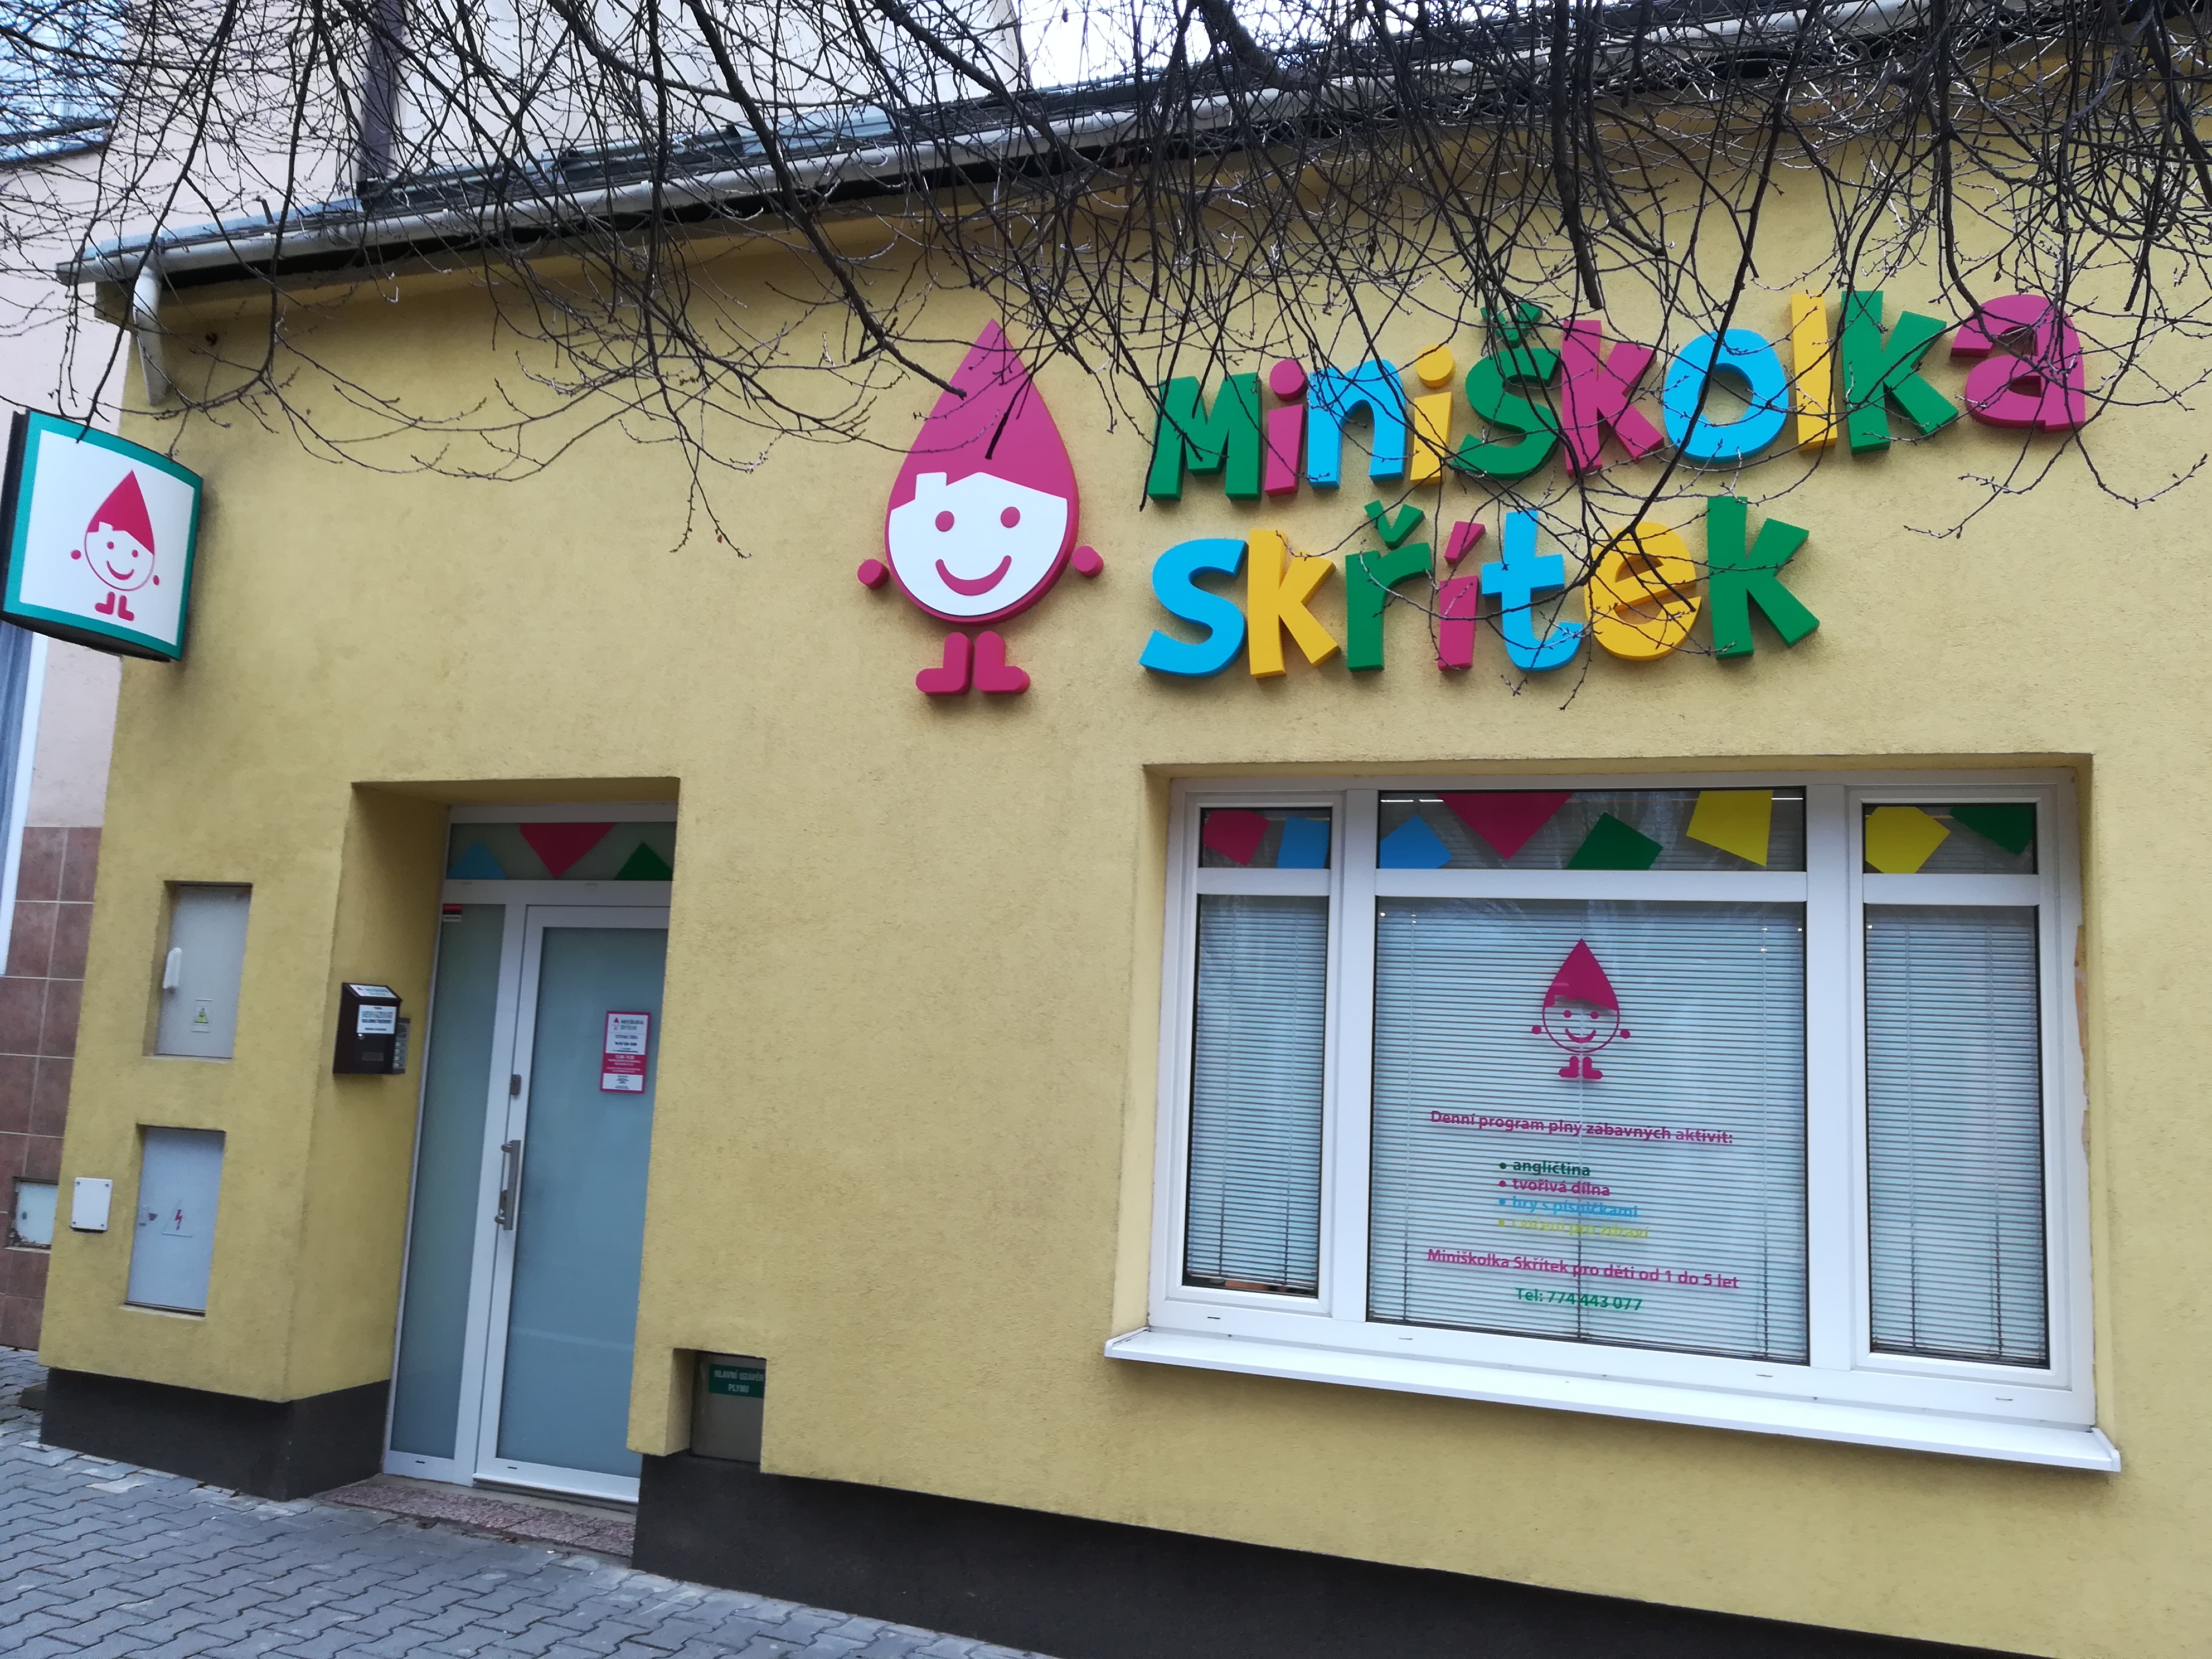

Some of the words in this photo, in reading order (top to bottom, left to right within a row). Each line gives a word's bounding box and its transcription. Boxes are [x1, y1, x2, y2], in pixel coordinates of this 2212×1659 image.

[1146, 290, 2087, 501] Miniškolka
[1139, 495, 1820, 678] Skřítek
[1430, 1110, 1476, 1125] Denní
[1479, 1117, 1544, 1132] program
[1549, 1119, 1582, 1137] plný
[1586, 1122, 1671, 1141] zábavných
[1676, 1128, 1733, 1143] aktivit:
[1512, 1161, 1590, 1176] angličtina
[1512, 1178, 1567, 1193] tvořivá
[1571, 1181, 1611, 1196] dílna
[1512, 1196, 1539, 1212] hry
[1542, 1201, 1549, 1211] s
[1553, 1199, 1638, 1217] písničkami
[1600, 1224, 1648, 1239] zdraví
[1427, 1249, 1510, 1268] Miniškolka
[1513, 1256, 1569, 1273] Skřítek
[1573, 1263, 1599, 1277] pro
[1604, 1264, 1634, 1279] děti
[1639, 1268, 1660, 1282] od
[1665, 1270, 1672, 1283] 1
[1678, 1270, 1699, 1285] do
[1703, 1274, 1713, 1286] 5
[1718, 1274, 1739, 1289] let
[1515, 1287, 1544, 1302] Tel:
[1548, 1291, 1575, 1305] 774
[1580, 1294, 1609, 1308] 443
[1613, 1297, 1643, 1311] 077
